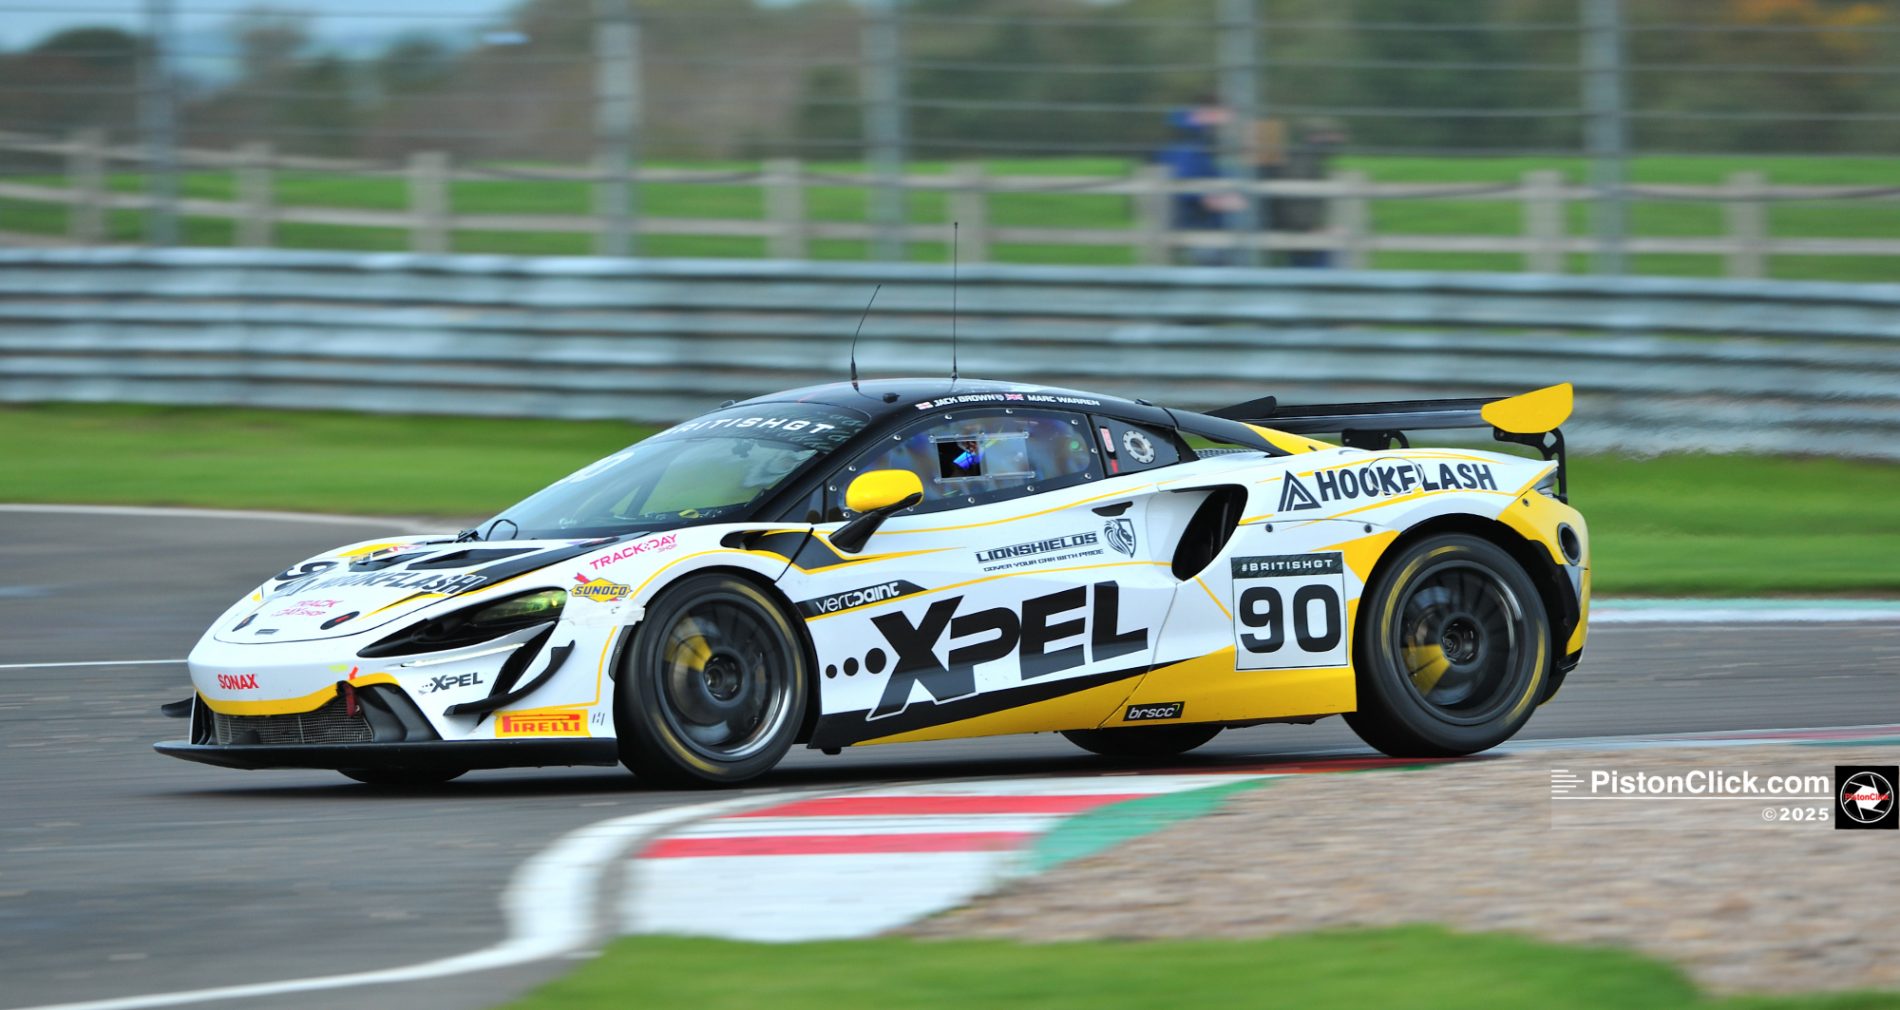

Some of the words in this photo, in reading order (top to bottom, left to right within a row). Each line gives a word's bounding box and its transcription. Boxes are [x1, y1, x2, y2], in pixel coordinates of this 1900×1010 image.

[934, 397, 957, 407] JACK
[957, 394, 995, 403] BROWN
[1027, 395, 1056, 403] MARC
[1056, 397, 1101, 406] WARREN
[1315, 463, 1498, 501] HOOKFLASH
[975, 532, 1099, 563] LIONSHIELDS
[1013, 560, 1037, 568] YOUR
[1057, 553, 1078, 561] WITH
[1079, 549, 1104, 557] PRIDE
[1241, 558, 1334, 572] #BRITISHGT
[574, 585, 628, 596] SUNOCO
[1239, 584, 1342, 654] 90
[866, 580, 1149, 718] XPEL
[217, 673, 260, 690] SONAX
[430, 672, 483, 693] XPEL
[1128, 706, 1175, 719] brscc
[502, 714, 581, 733] PIRELLI
